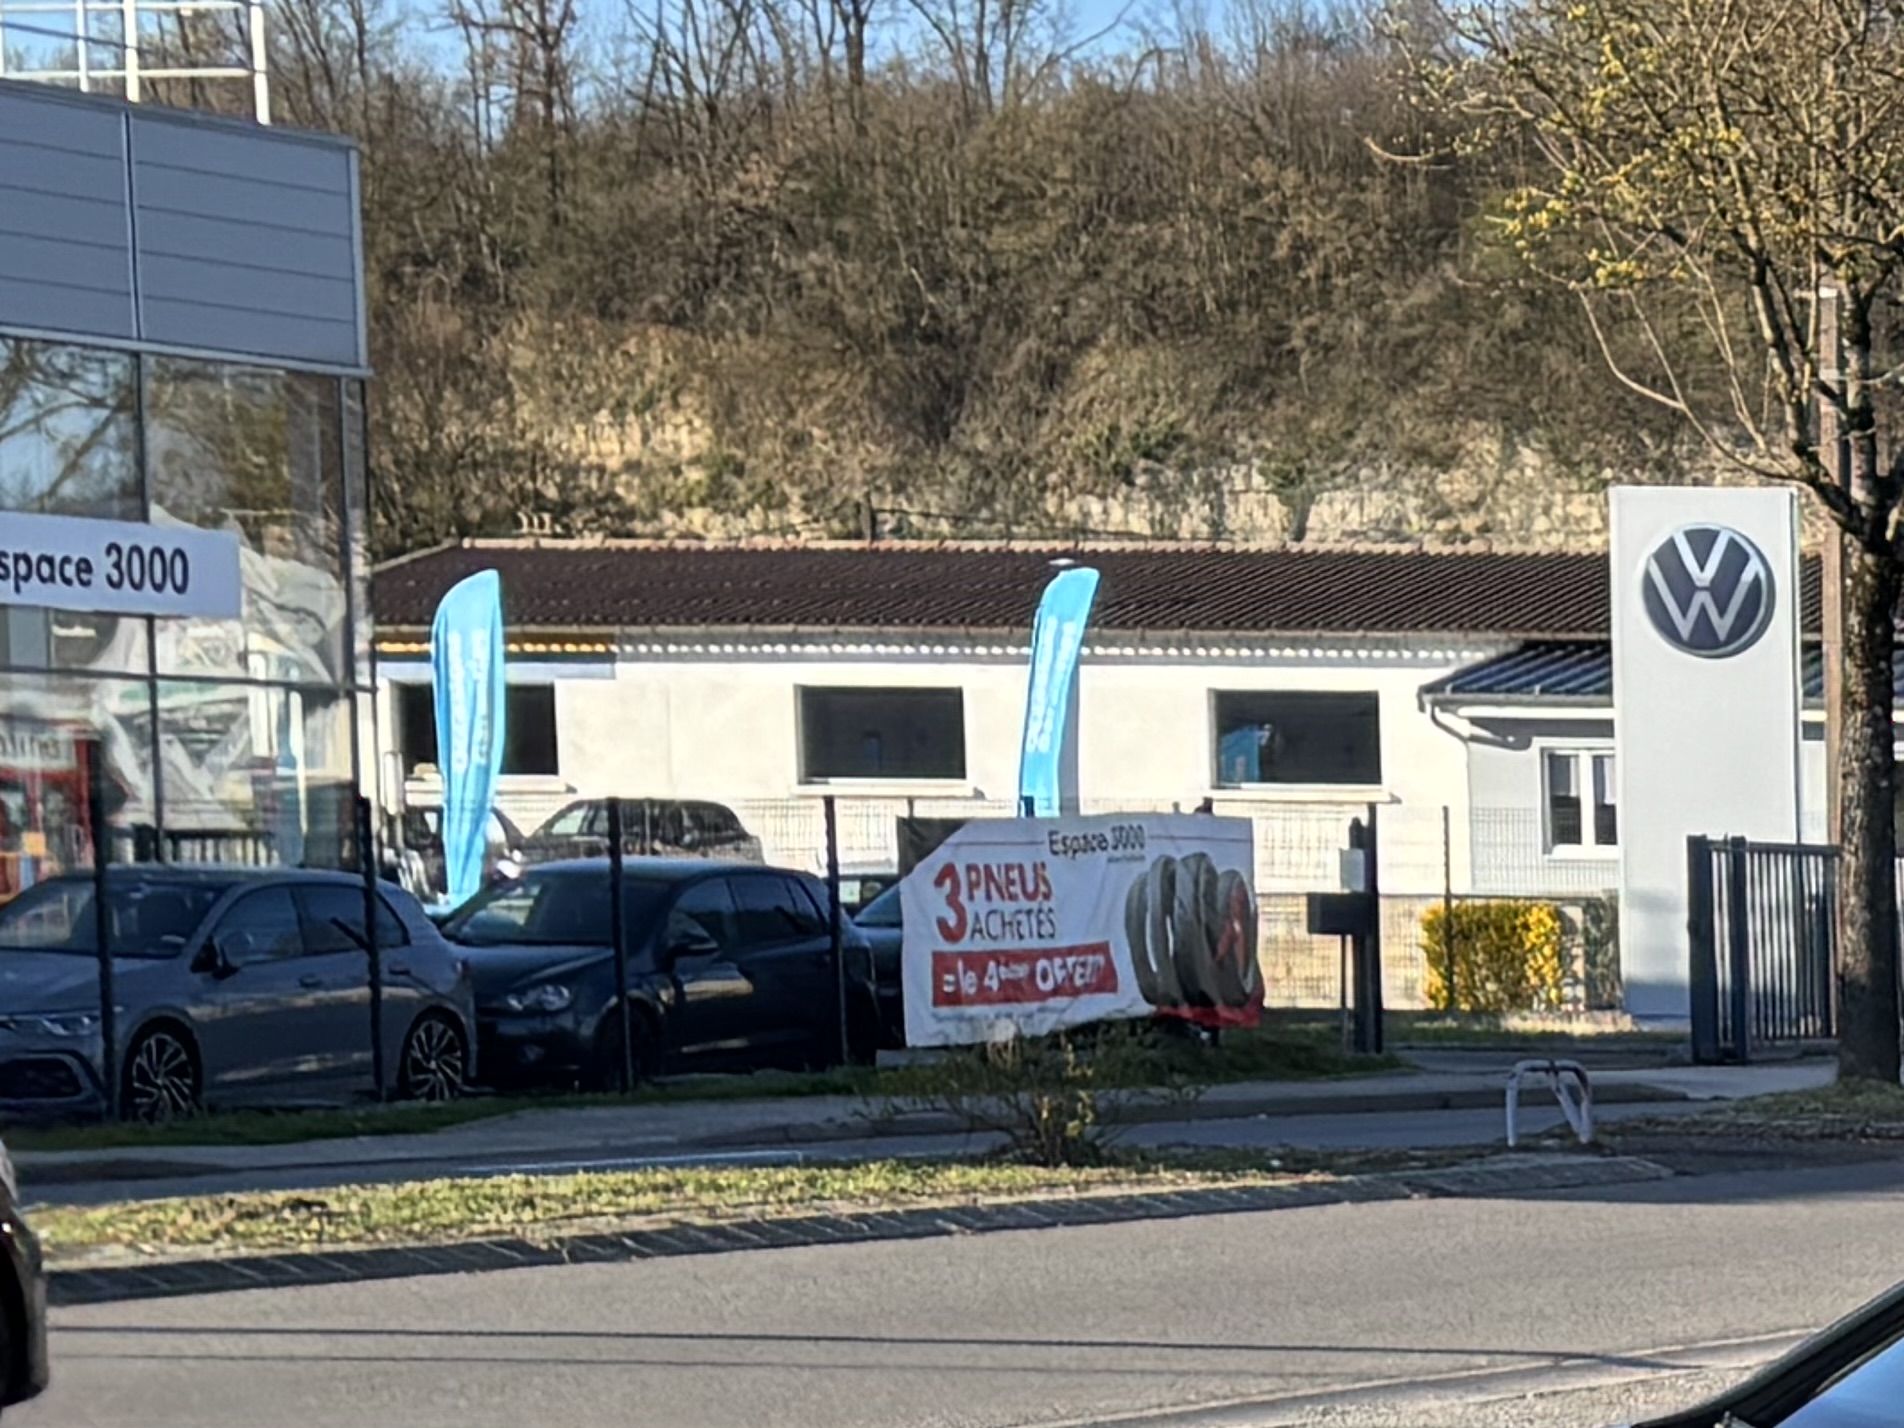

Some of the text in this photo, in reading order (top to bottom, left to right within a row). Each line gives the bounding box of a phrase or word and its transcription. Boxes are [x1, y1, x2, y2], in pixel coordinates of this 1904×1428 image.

[105, 542, 190, 595] 3000
[934, 861, 968, 945] 3
[965, 861, 1053, 903] PNEUS
